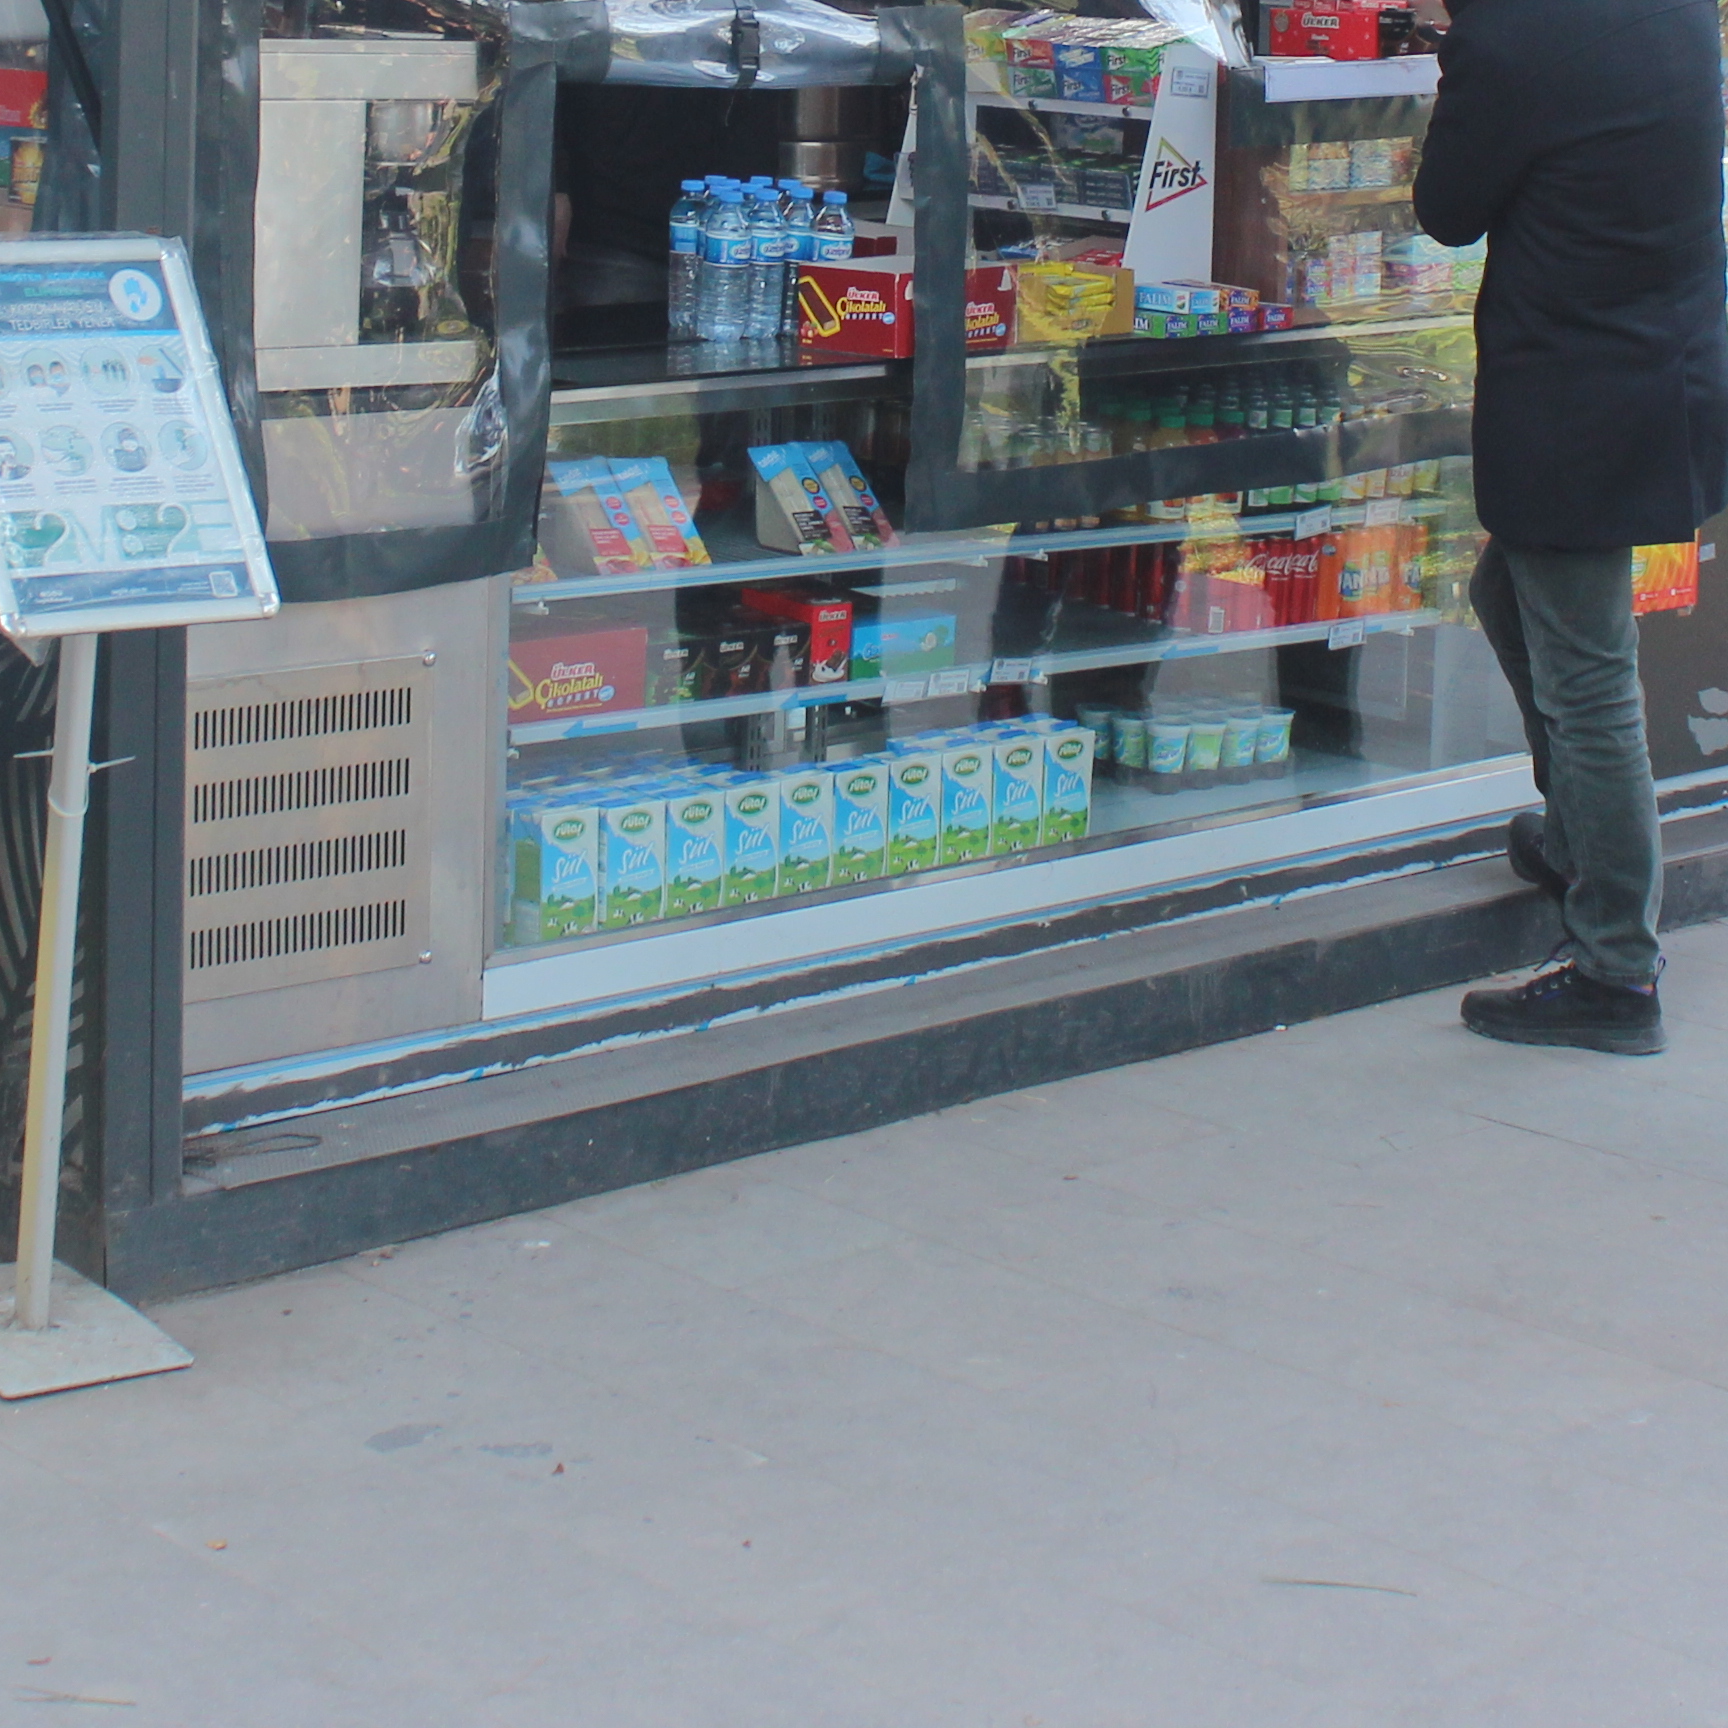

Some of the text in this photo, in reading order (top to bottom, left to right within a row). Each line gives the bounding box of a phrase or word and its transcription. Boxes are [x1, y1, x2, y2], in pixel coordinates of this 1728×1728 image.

[1302, 12, 1339, 28] ÜLKER
[1013, 47, 1032, 59] First
[1107, 54, 1127, 67] First
[1063, 79, 1083, 91] First
[1111, 83, 1132, 96] First
[1149, 160, 1201, 189] First
[847, 287, 880, 302] ÜLKER
[1139, 291, 1172, 306] FALIM
[551, 663, 595, 680] ÜLKER
[535, 673, 604, 709] Çikolatalı
